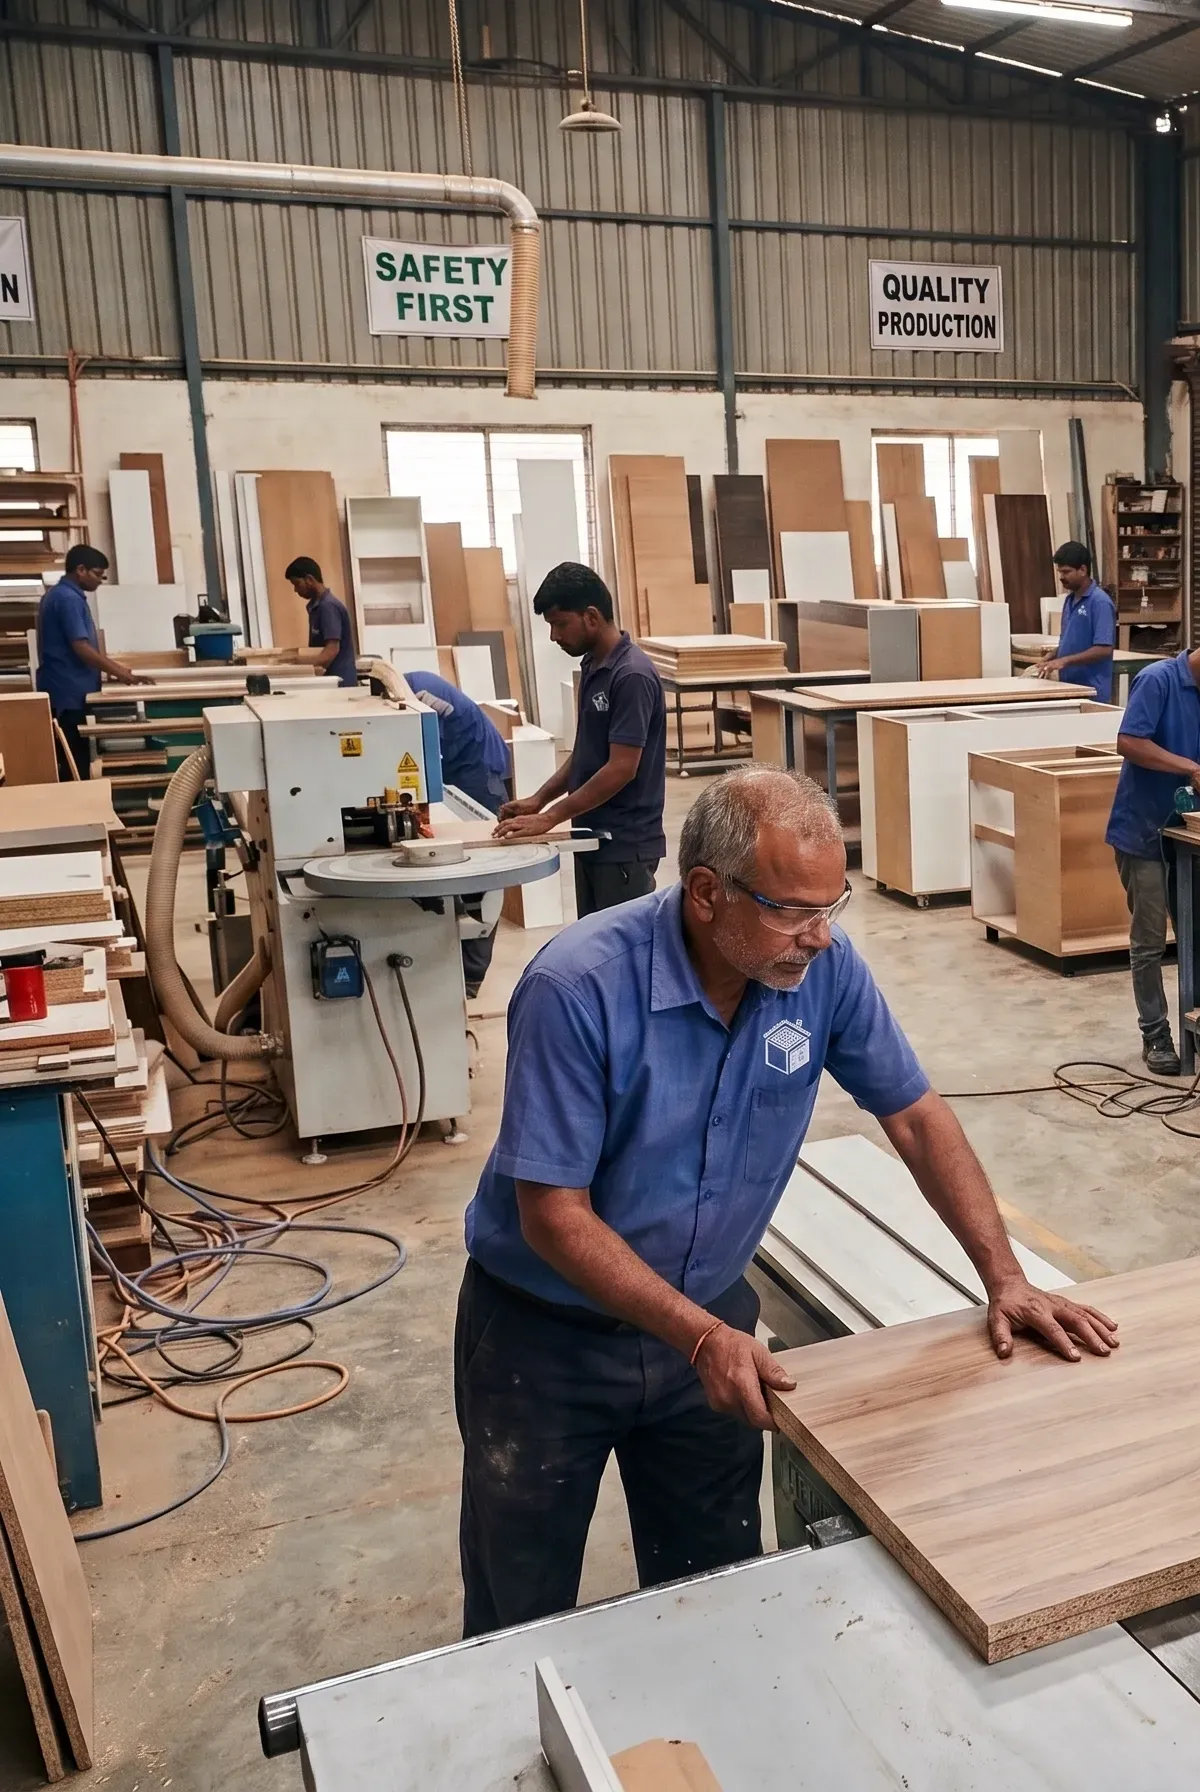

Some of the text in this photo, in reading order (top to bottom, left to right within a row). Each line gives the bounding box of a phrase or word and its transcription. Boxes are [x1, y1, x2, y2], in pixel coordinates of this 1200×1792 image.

[375, 251, 508, 286] SAFETY
[882, 273, 990, 304] QUALITY
[396, 291, 494, 323] FIRST
[878, 311, 996, 339] PRODUCTION
